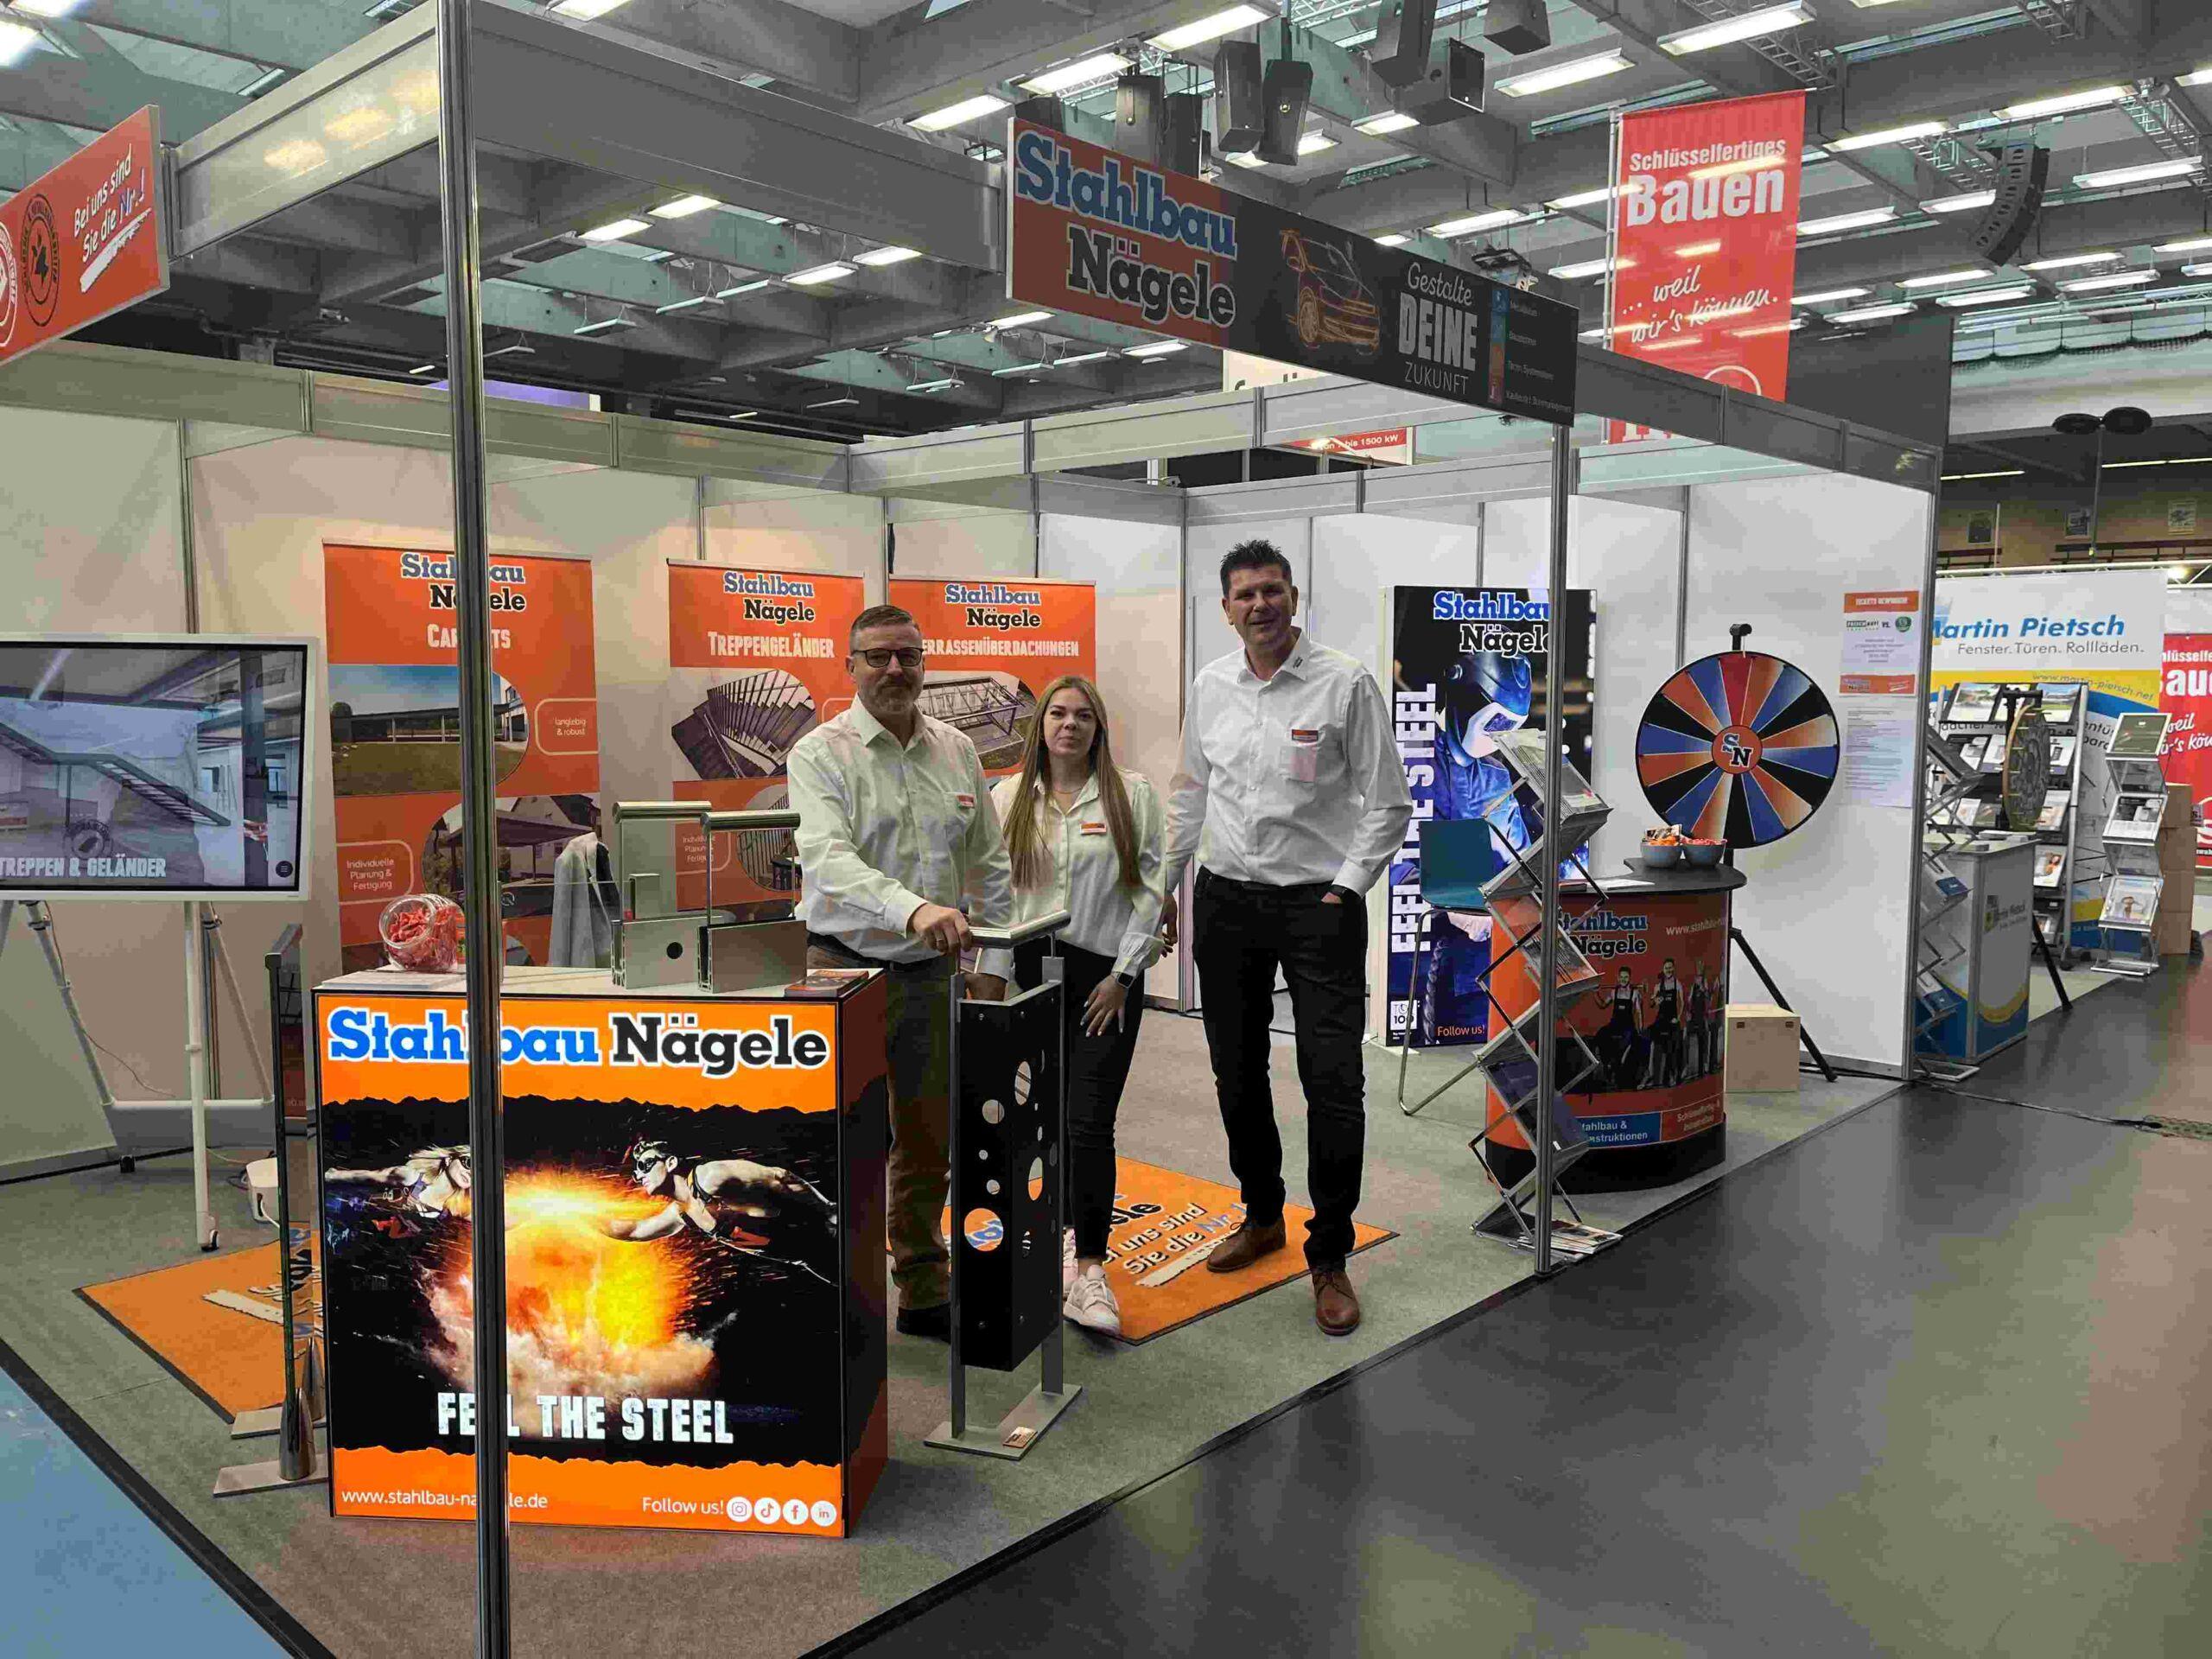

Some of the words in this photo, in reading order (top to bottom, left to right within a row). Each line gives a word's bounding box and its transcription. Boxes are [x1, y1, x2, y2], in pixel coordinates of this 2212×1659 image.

[1630, 139, 1786, 172] Schlüsselfertiges
[73, 195, 90, 238] Bei
[89, 180, 109, 216] uns
[109, 143, 132, 194] sind
[1015, 130, 1236, 260] Stahlbau
[1626, 168, 1785, 227] Bauen
[82, 226, 99, 263] Sie
[100, 207, 118, 240] die
[1066, 221, 1236, 327] Nägele
[1408, 261, 1472, 307] Gestalte
[1398, 292, 1478, 372] DEINE
[1405, 361, 1469, 396] ZUKUNFT
[1361, 436, 1382, 446] 1500
[1384, 434, 1400, 443] kW
[401, 552, 525, 584] Staau
[723, 570, 815, 597] Stahlbau
[945, 583, 1041, 605] Stahlbau
[429, 583, 527, 612] Nele
[743, 598, 817, 625] Nägele
[966, 607, 1041, 631] Nägele
[427, 624, 512, 649] CATS
[2020, 614, 2125, 637] Pietsch
[708, 632, 835, 658] TREPPENGELÄNDER
[922, 636, 1079, 657] ERRASSENÜBERDACHUNGEN
[1958, 643, 2012, 655] Fenster.
[2015, 641, 2063, 654] Türen.
[2066, 639, 2145, 654] Rollläden.
[2160, 669, 2212, 696] au
[1396, 683, 1436, 788] STEEL
[87, 853, 167, 877] GELÄNDER
[346, 857, 395, 869] Individuelle
[350, 870, 385, 880] Planung
[353, 881, 393, 891] Fertigung
[328, 1007, 601, 1065] Stahau
[608, 1011, 830, 1078] Nägele
[1437, 1026, 1470, 1037] Follow
[1471, 1025, 1485, 1035] us!
[1621, 1120, 1628, 1130] &
[1118, 1228, 1163, 1251] uns
[1159, 1202, 1209, 1230] sind
[1123, 1250, 1171, 1274] Sie
[1166, 1231, 1206, 1252] die
[437, 1393, 521, 1437] FEL
[537, 1395, 606, 1440] THE
[621, 1396, 734, 1444] STEEL
[342, 1489, 549, 1510] www.stahlbau-nale.de
[641, 1497, 698, 1516] Follow
[701, 1500, 725, 1516] us!
